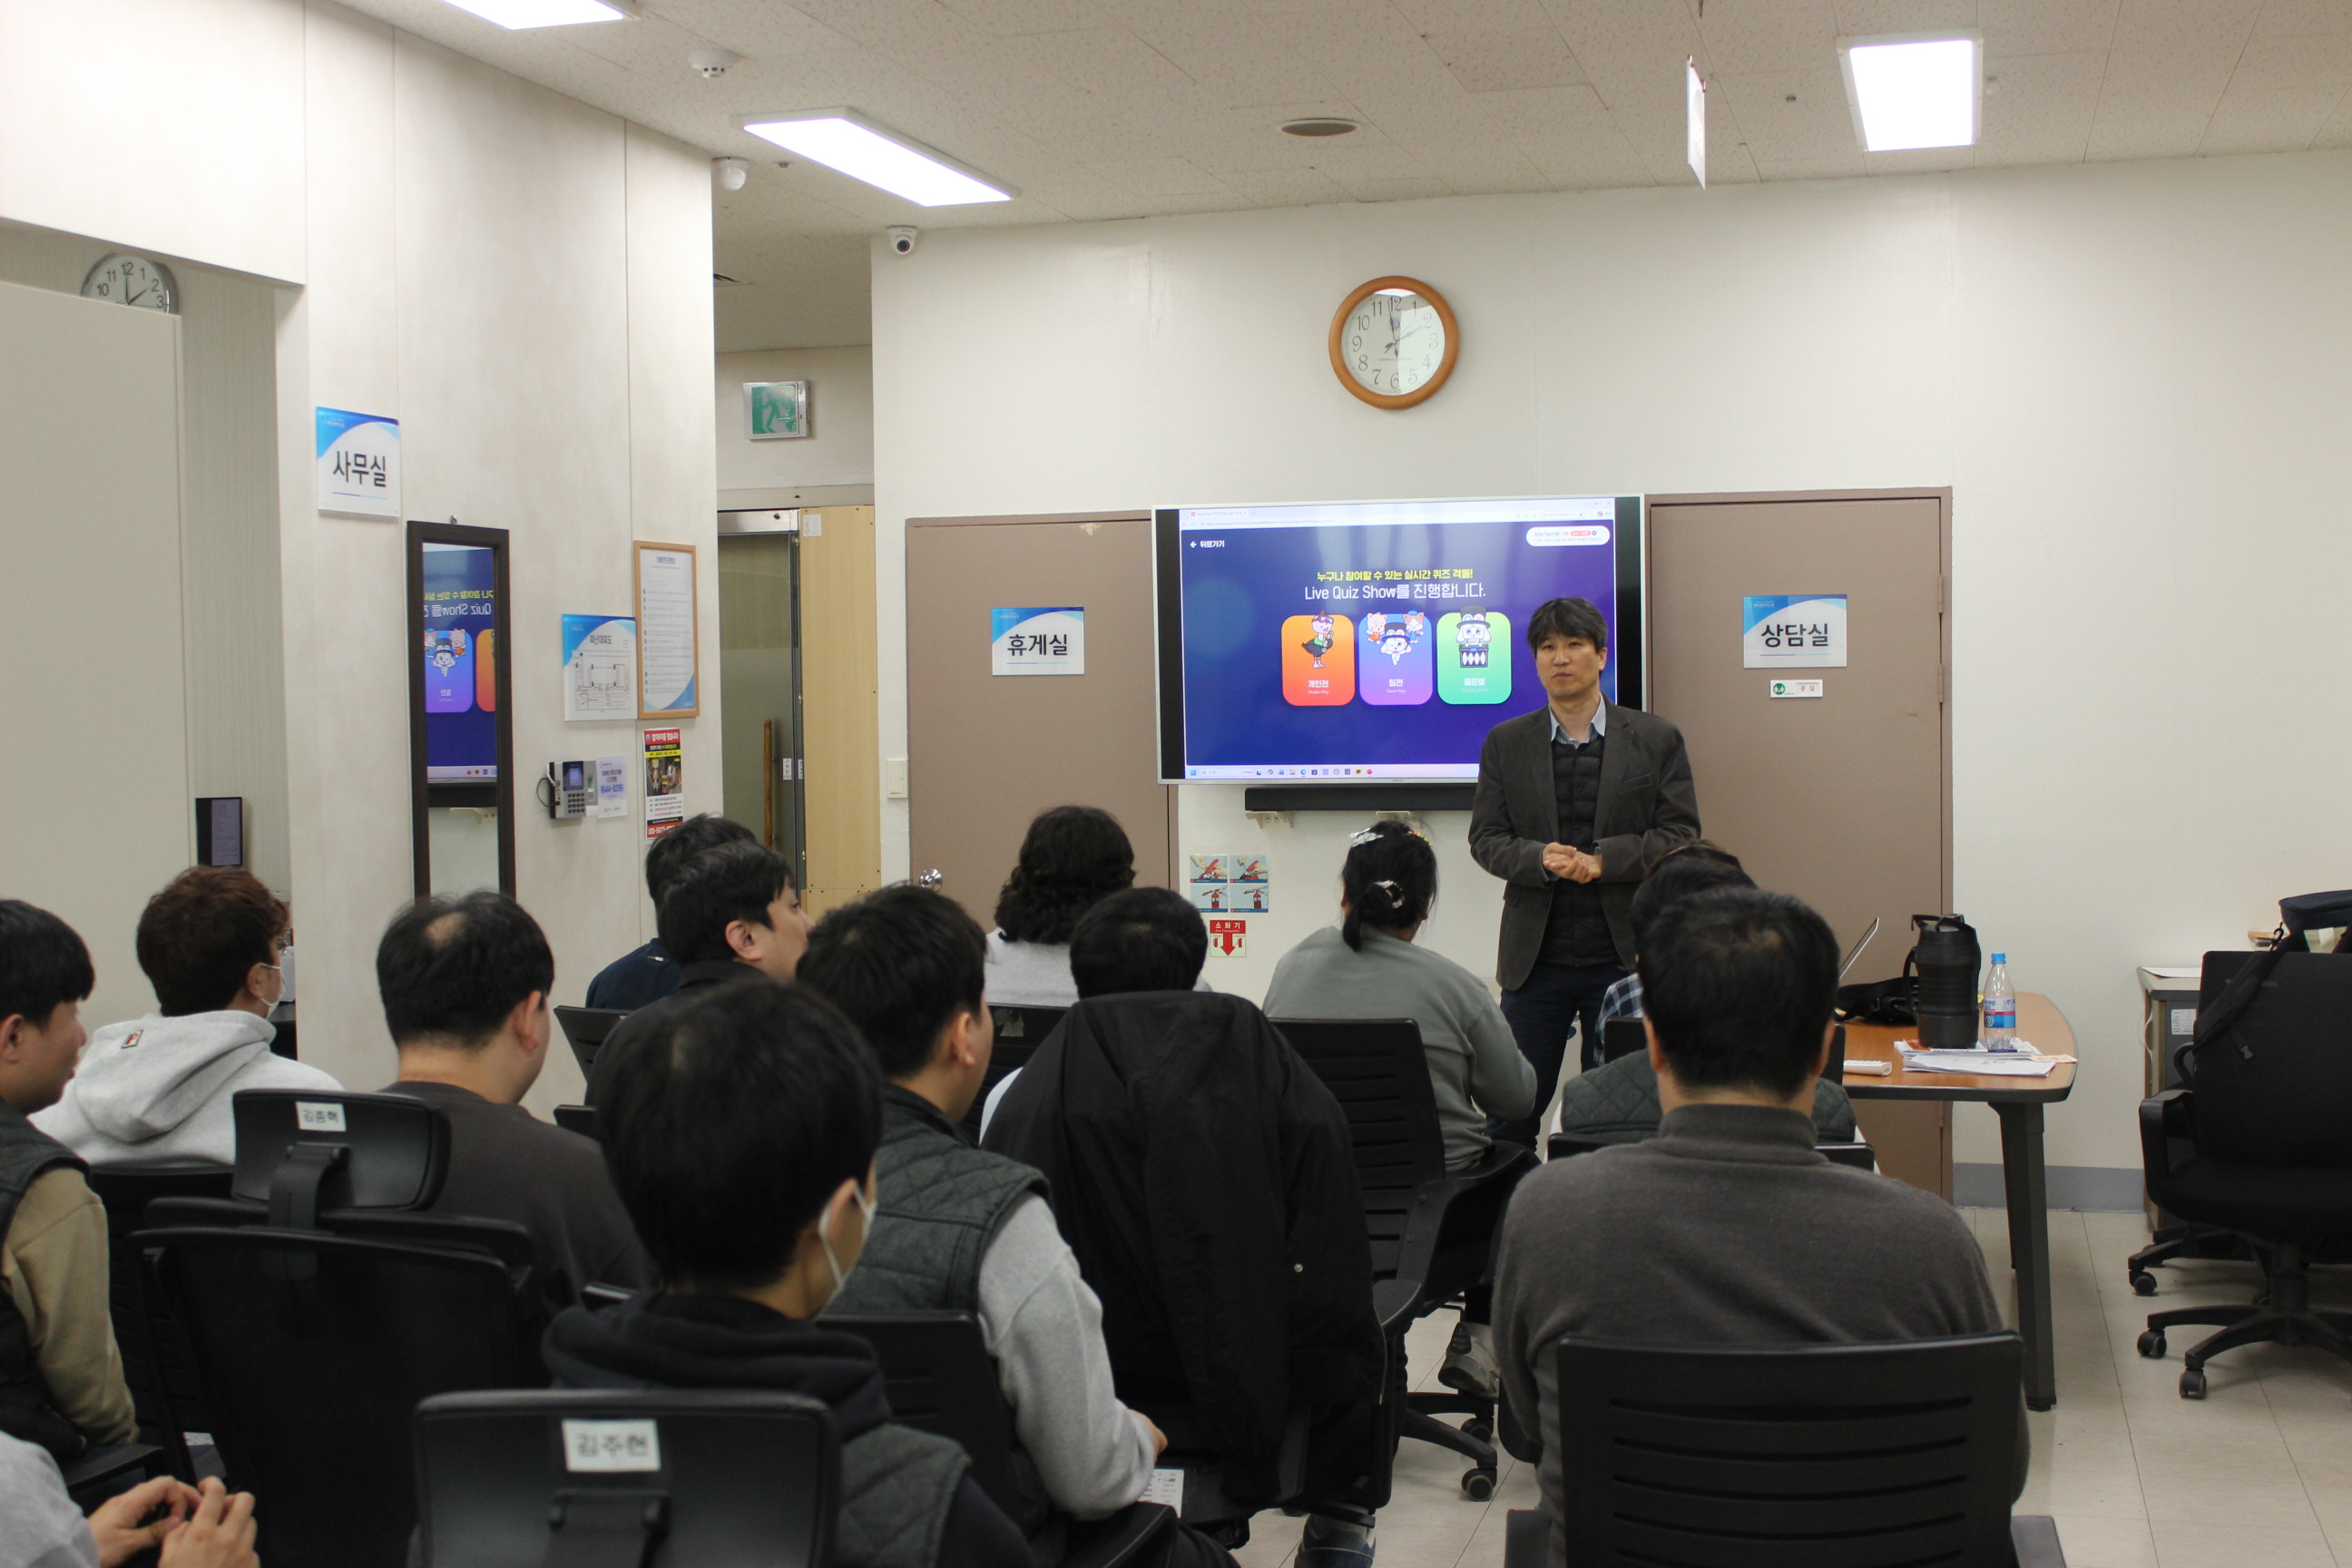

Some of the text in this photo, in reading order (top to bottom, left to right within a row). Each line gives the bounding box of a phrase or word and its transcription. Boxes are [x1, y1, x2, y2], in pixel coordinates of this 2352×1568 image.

[106, 270, 116, 282] 11
[121, 262, 133, 276] 12
[141, 268, 145, 280] 1
[97, 283, 109, 297] 10
[152, 279, 160, 292] 2
[1371, 300, 1382, 317] 11
[1389, 296, 1402, 311] 12
[1412, 300, 1416, 316] 1
[1357, 315, 1370, 330] 10
[1423, 312, 1432, 328] 2
[1352, 336, 1362, 352] 9
[1428, 333, 1438, 349] 3
[1358, 355, 1367, 371] 8
[1422, 354, 1432, 369] 4
[1372, 369, 1381, 385] 7
[1390, 373, 1399, 388] 6
[1408, 368, 1417, 385] 5
[333, 450, 387, 488] 사무실
[1200, 540, 1225, 548] 뒤로가기
[1318, 572, 1343, 582] 누구나
[1346, 571, 1372, 581] 참여할
[1374, 571, 1382, 581] 수
[1385, 570, 1402, 581] 있는
[1405, 570, 1431, 580] 실시간
[1433, 569, 1451, 579] 퀴즈
[1305, 583, 1486, 600] Live Quiz Show를 진행합니다.
[1761, 623, 1828, 648] 상담실
[1007, 633, 1068, 656] 휴게실
[1308, 680, 1328, 688] 개인전
